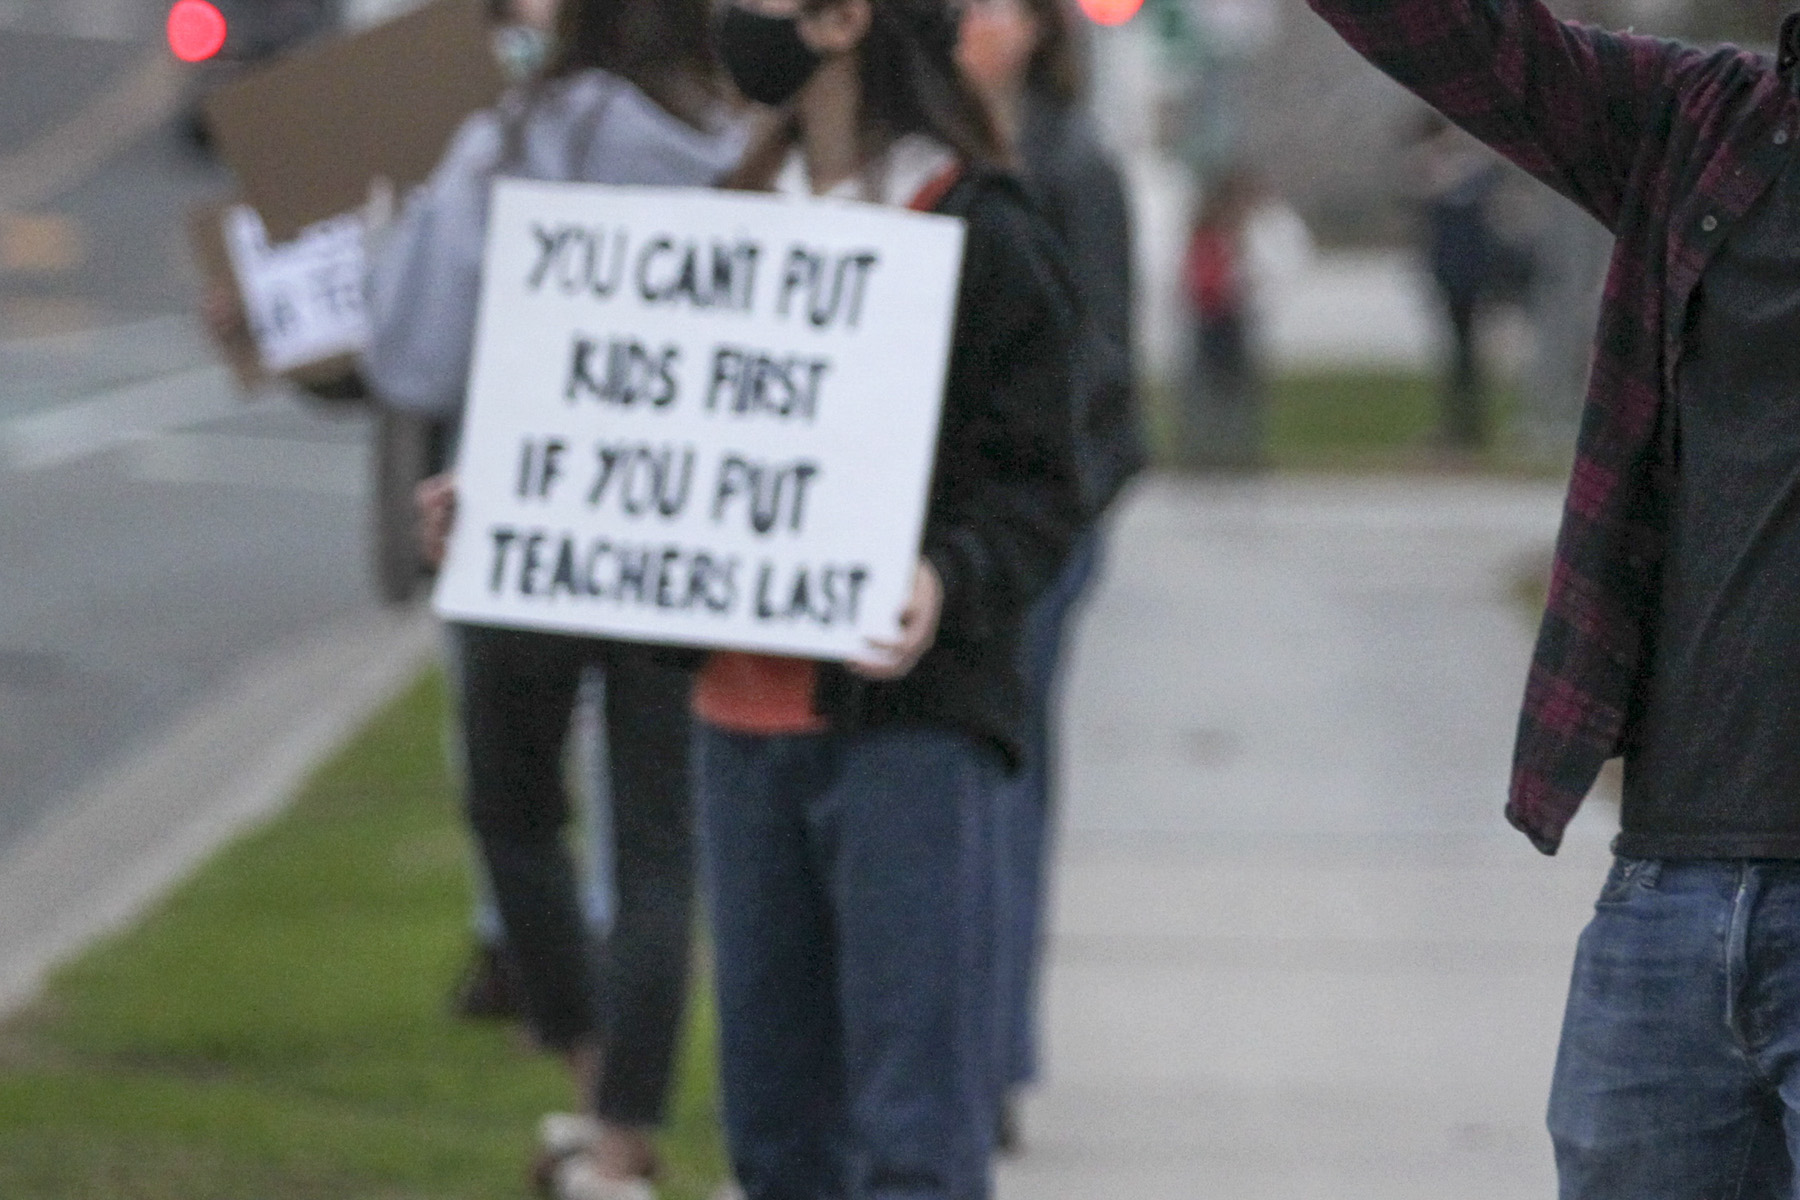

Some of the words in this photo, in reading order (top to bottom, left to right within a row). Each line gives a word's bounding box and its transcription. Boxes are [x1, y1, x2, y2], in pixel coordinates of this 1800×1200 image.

[529, 222, 627, 296] YOU
[776, 243, 880, 330] PUT
[566, 332, 681, 408] KIDS
[704, 343, 826, 421] FIRST
[515, 432, 567, 500] IF
[587, 439, 695, 516] YOU
[711, 453, 817, 535] PUT
[490, 527, 738, 611] TEACHERS
[752, 558, 870, 628] LAST
